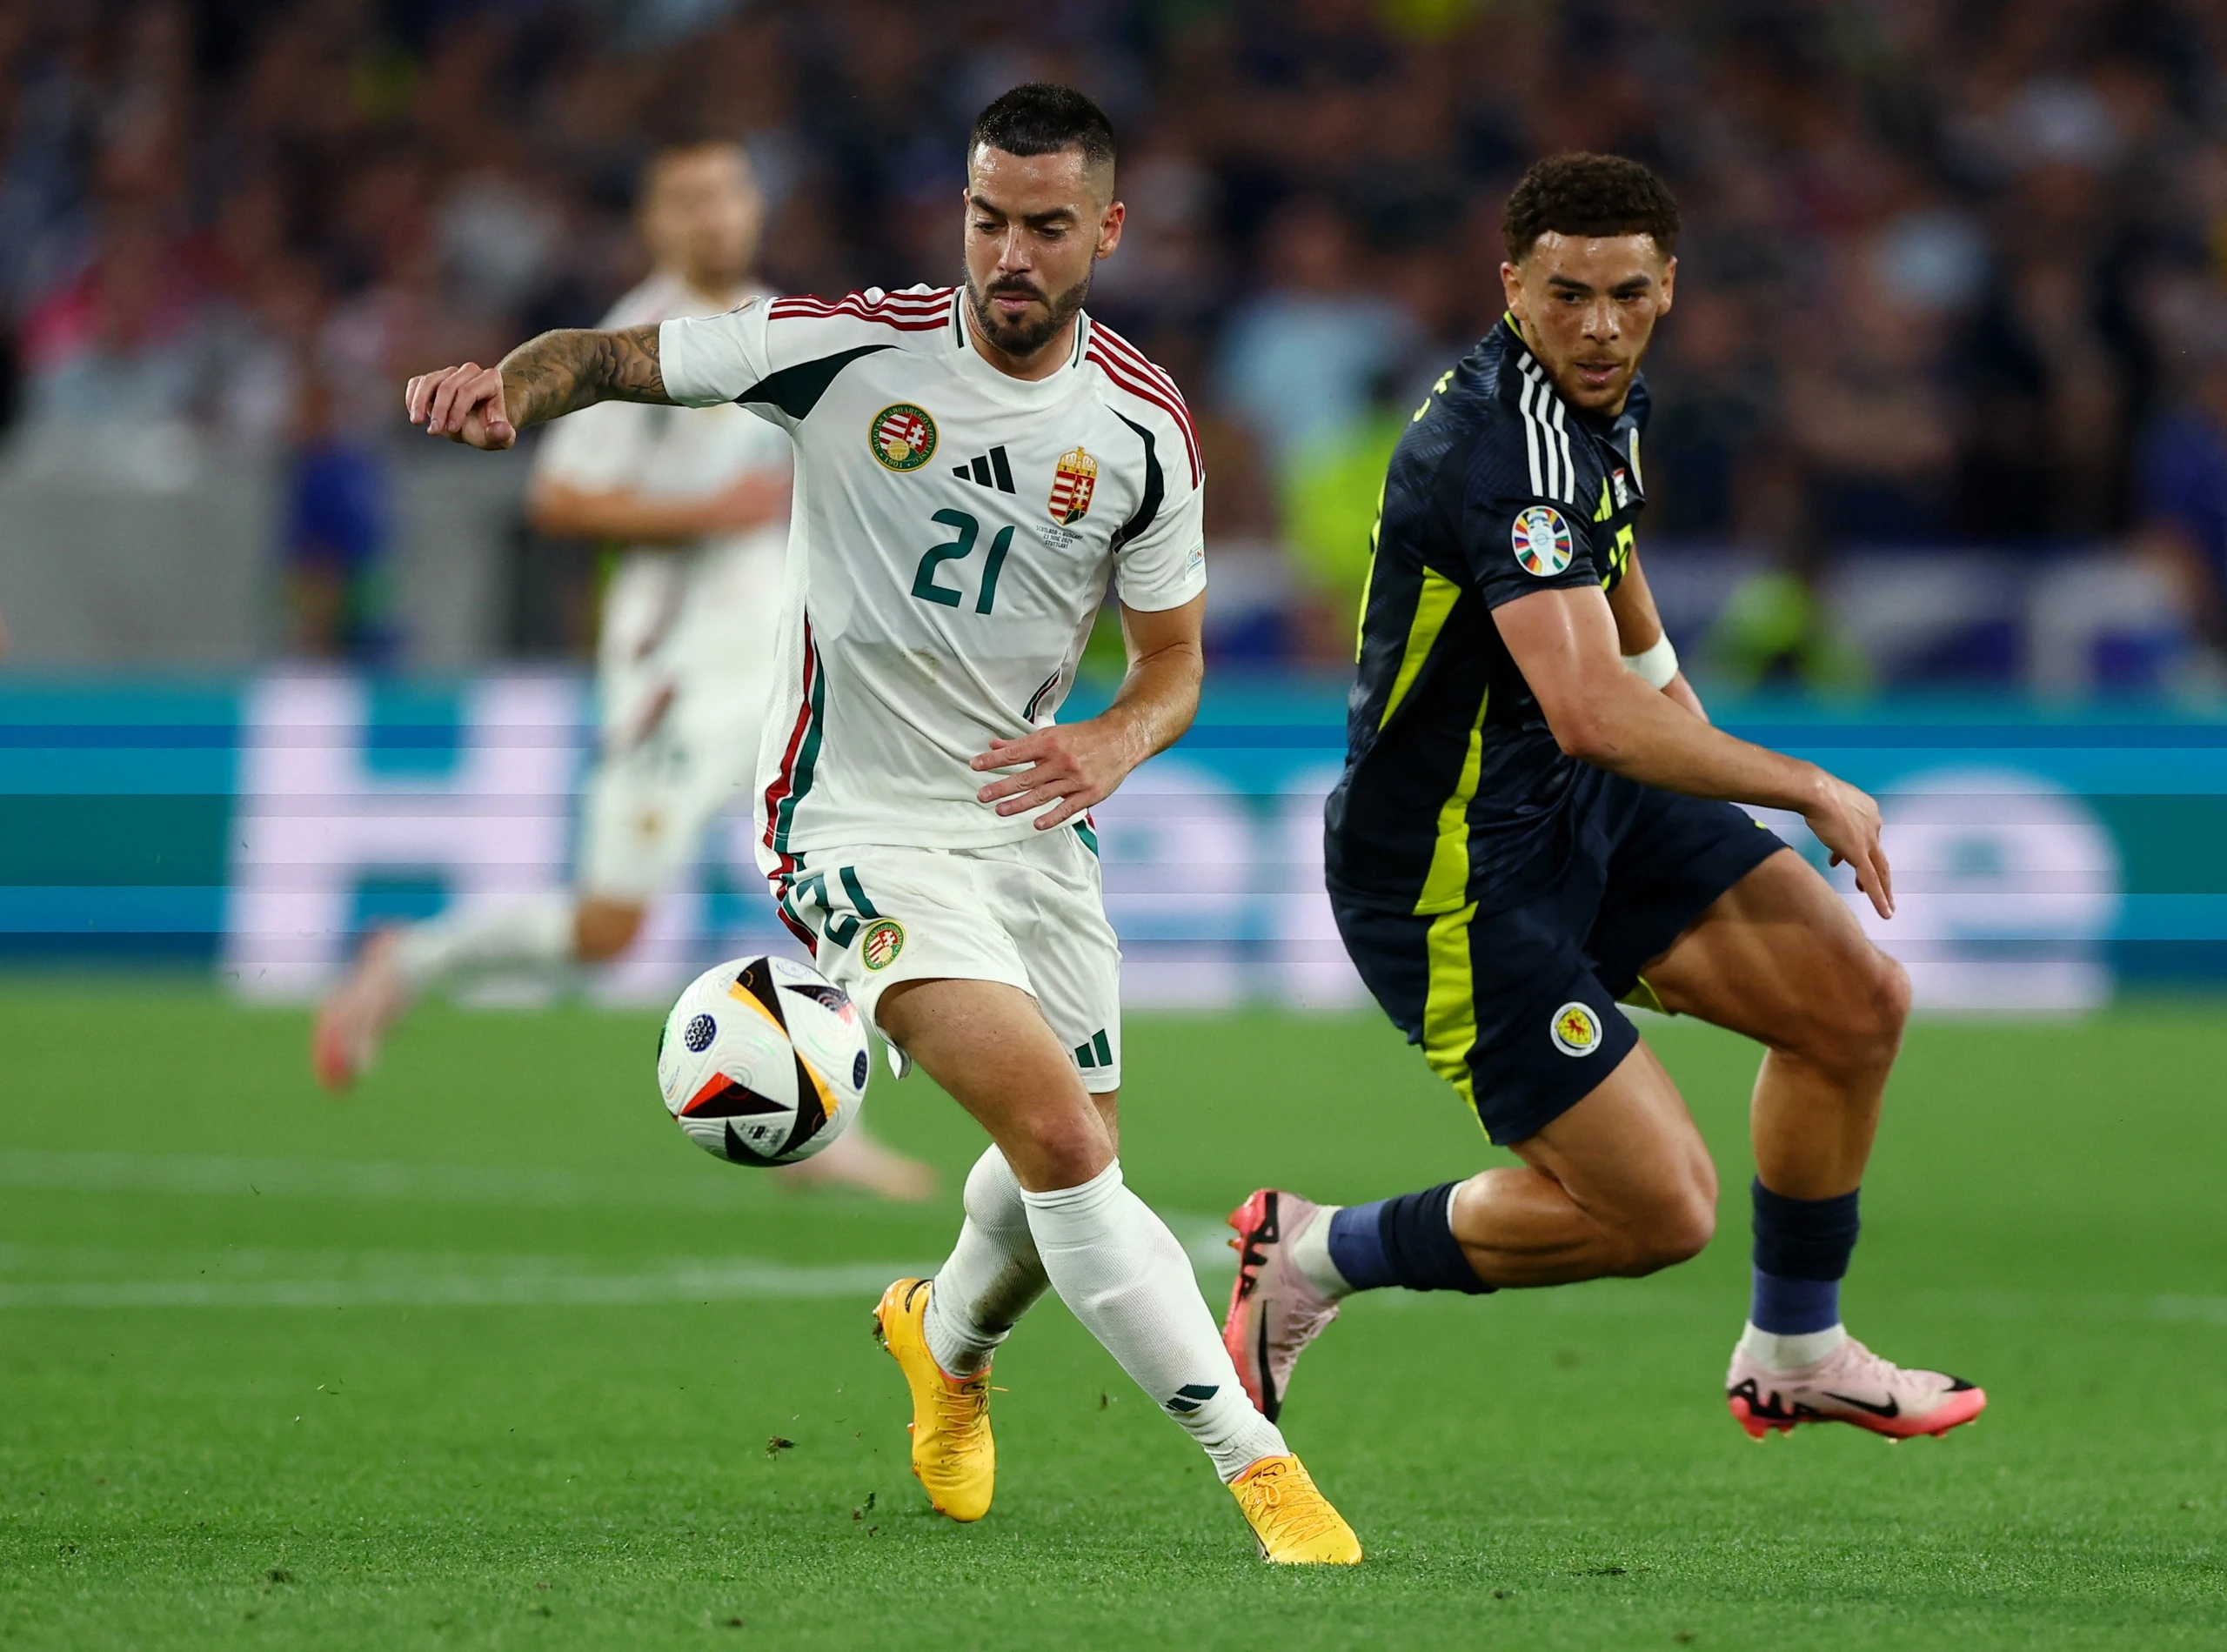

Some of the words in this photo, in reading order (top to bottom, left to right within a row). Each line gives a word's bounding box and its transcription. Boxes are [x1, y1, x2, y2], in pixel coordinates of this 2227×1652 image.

[884, 457, 903, 467] 1901
[1036, 525, 1058, 535] SCOTLAND
[1063, 531, 1083, 539] HUNGARY
[911, 508, 1015, 616] 21
[796, 866, 881, 949] 21
